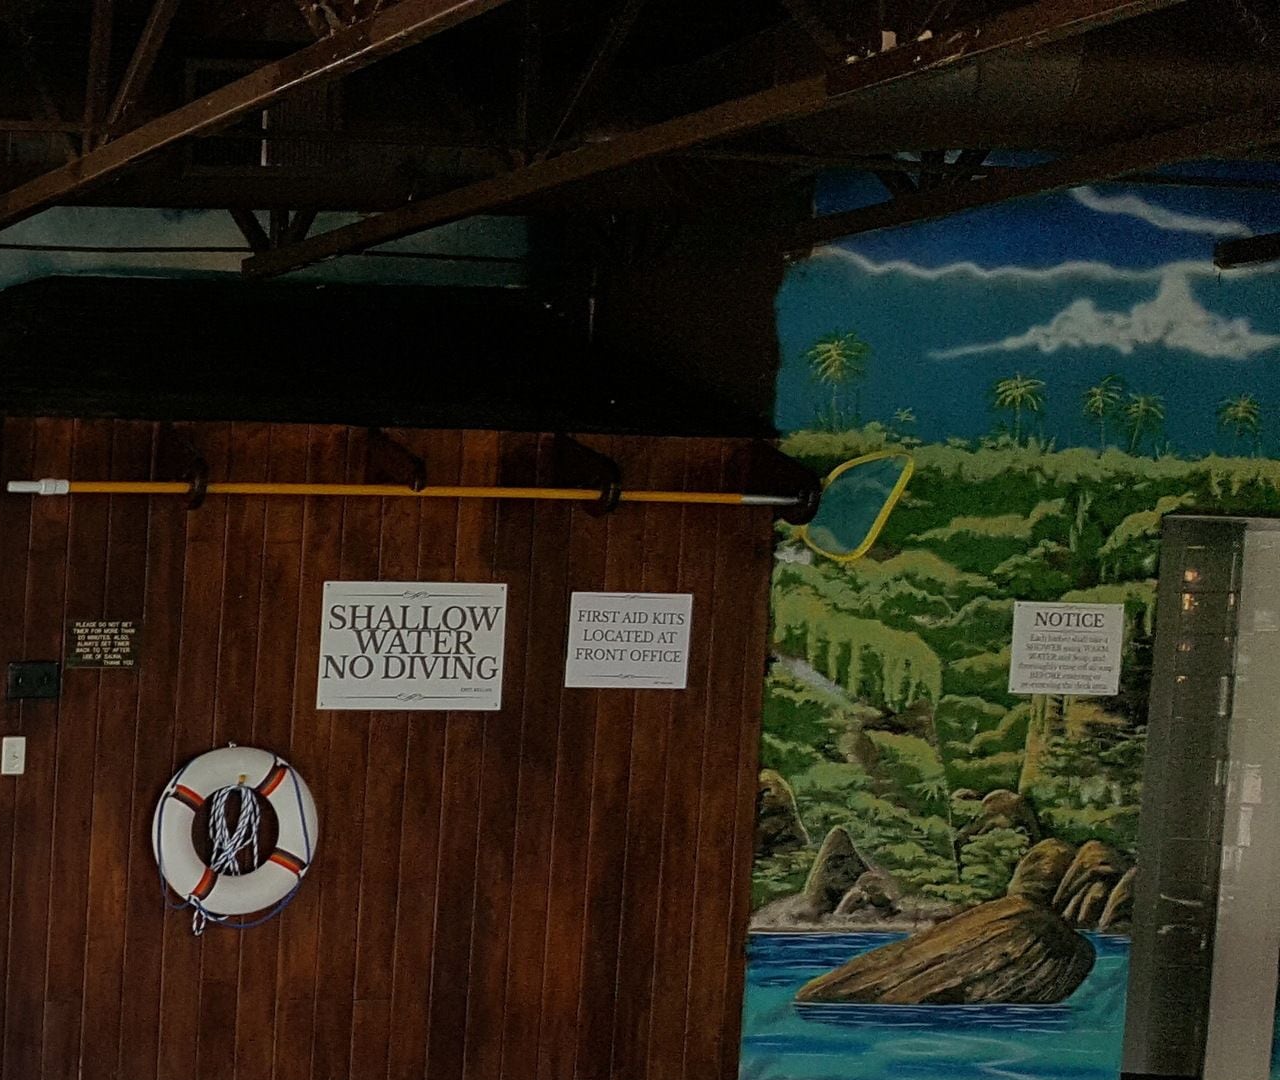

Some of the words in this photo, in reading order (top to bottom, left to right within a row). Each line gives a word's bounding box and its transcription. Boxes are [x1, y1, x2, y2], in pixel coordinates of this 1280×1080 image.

[328, 604, 502, 632] SHALLOW
[578, 610, 620, 623] FIRST
[622, 611, 648, 624] AID
[652, 612, 685, 626] KITS
[1034, 612, 1105, 628] NOTICE
[353, 629, 476, 655] WATER
[583, 629, 654, 643] LOCATED
[657, 631, 678, 644] AT
[575, 647, 627, 661] FRONT
[630, 649, 682, 663] OFFICE
[322, 655, 374, 680] NO
[381, 655, 499, 680] DIVING
